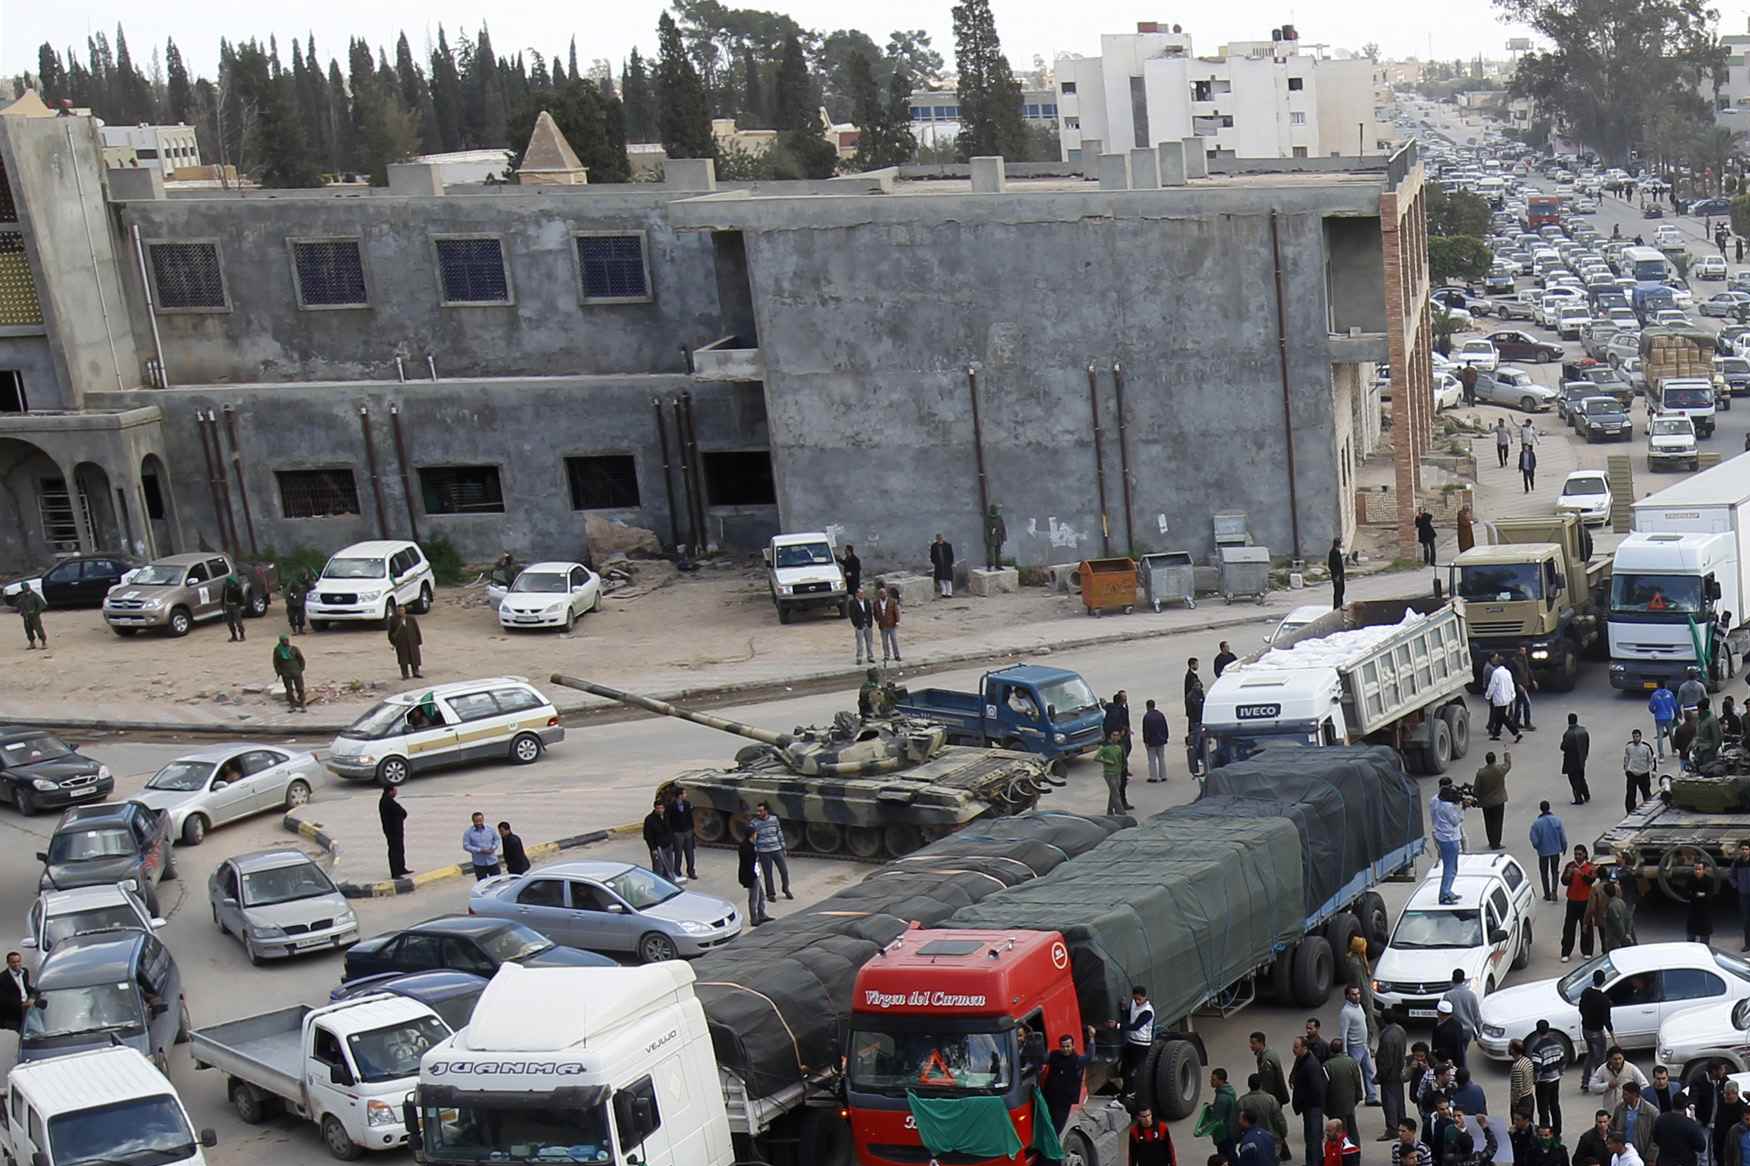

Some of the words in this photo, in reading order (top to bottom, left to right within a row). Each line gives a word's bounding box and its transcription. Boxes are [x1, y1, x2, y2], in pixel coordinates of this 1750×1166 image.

[1240, 706, 1276, 716] IVECO
[865, 990, 906, 1008] Virgen
[907, 991, 930, 1006] del
[931, 991, 986, 1006] Carmen
[431, 1061, 583, 1076] JUANMA
